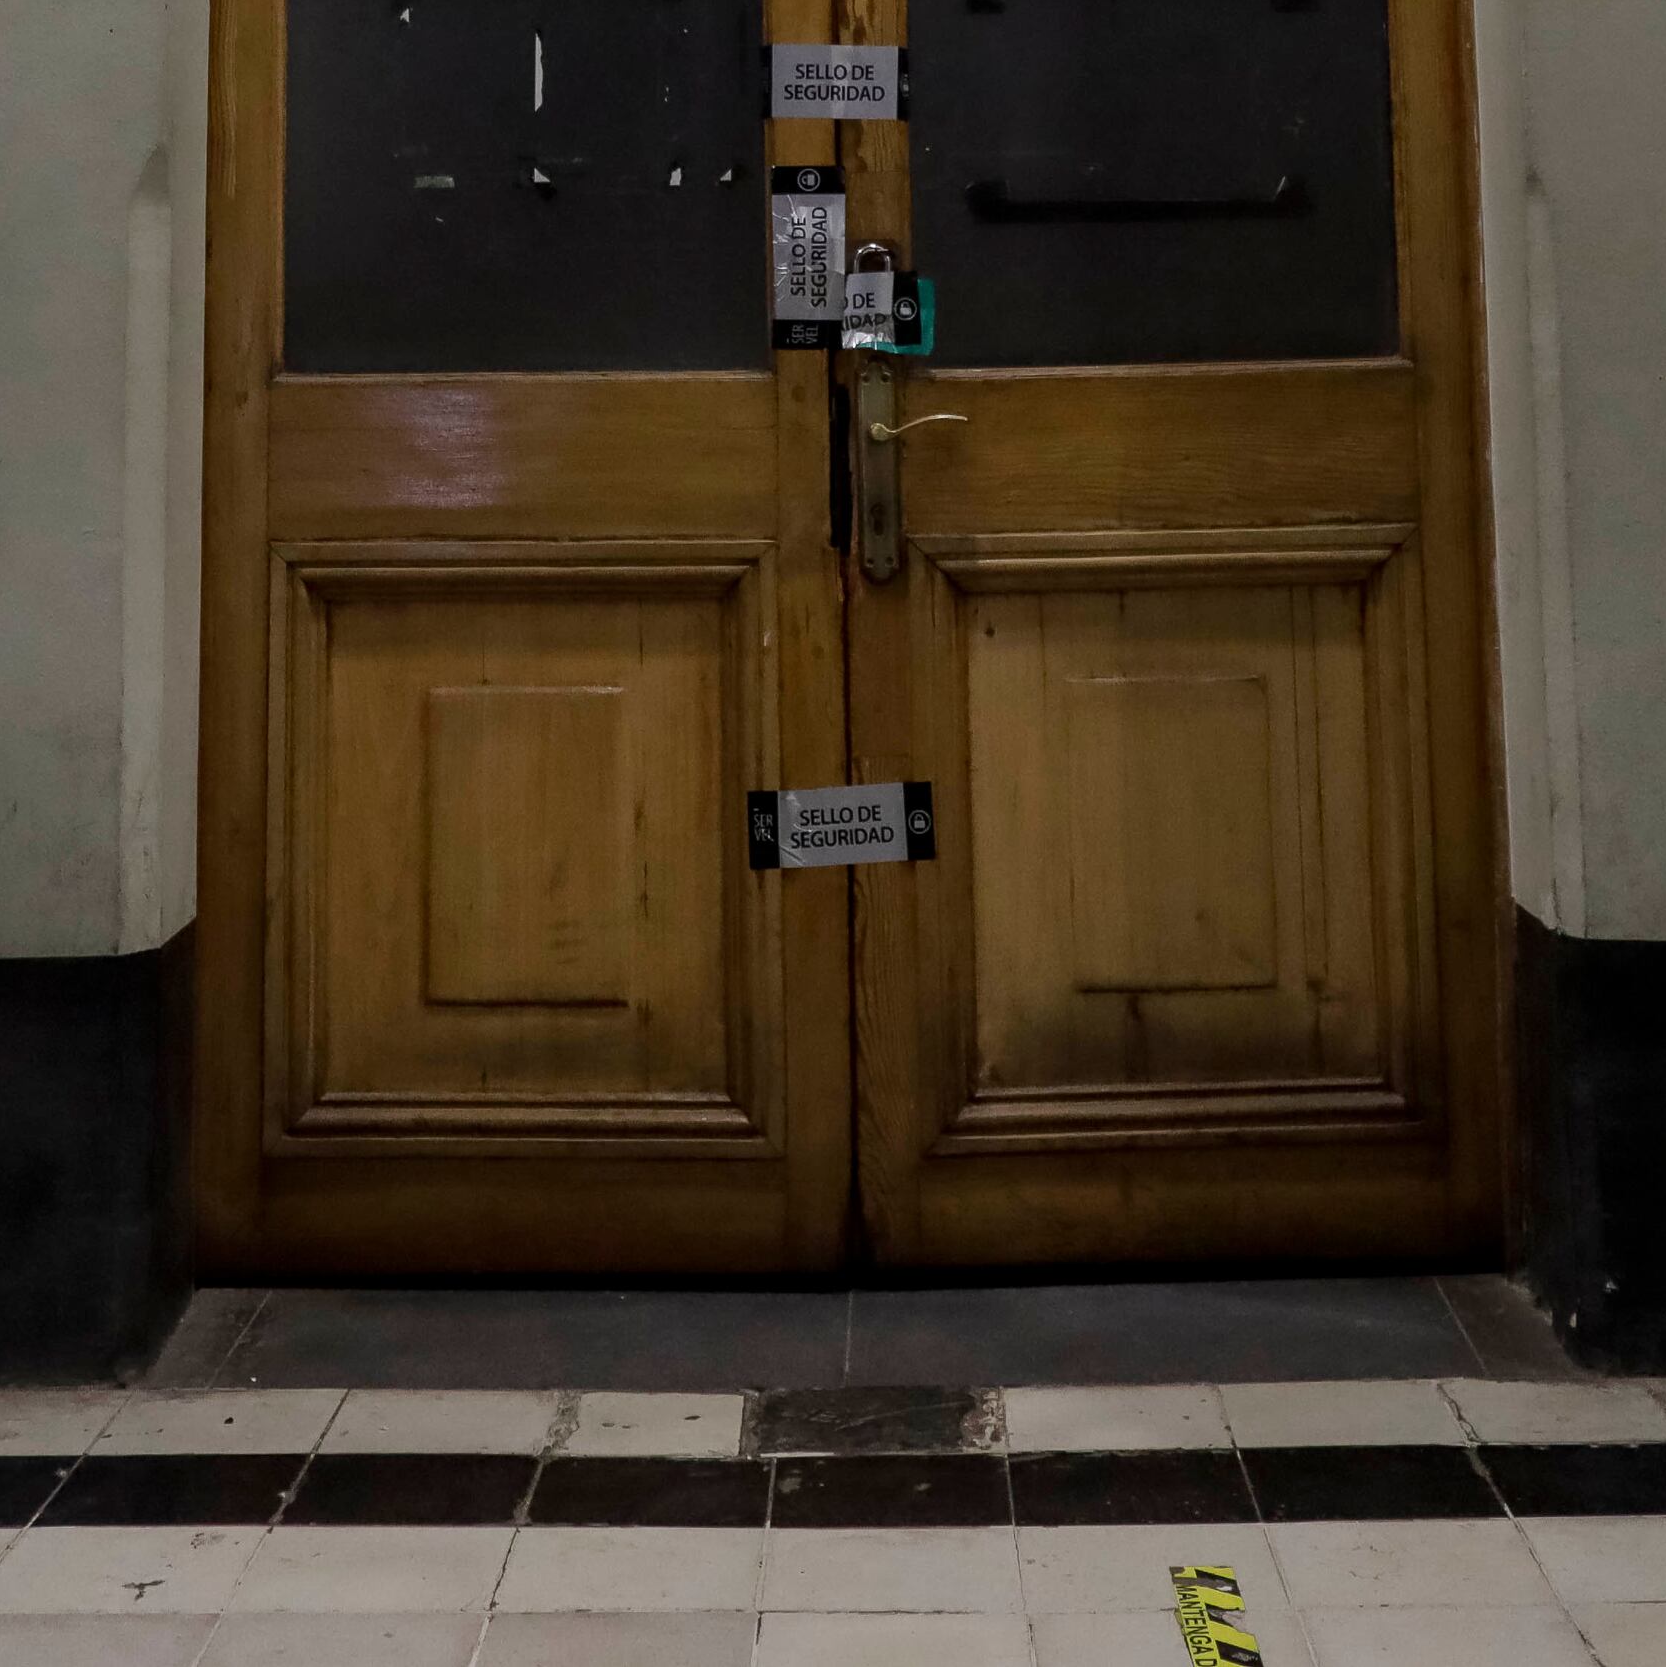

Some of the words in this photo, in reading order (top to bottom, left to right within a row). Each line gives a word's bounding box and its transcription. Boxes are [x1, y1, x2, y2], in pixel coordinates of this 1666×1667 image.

[795, 64, 847, 80] SELLO
[851, 64, 874, 80] DE
[783, 85, 885, 102] SEGURIDAD
[792, 217, 806, 239] DE
[811, 207, 827, 308] SEGURIDAD
[791, 243, 806, 297] SELLO
[853, 292, 876, 310] DE
[791, 324, 804, 344] SER
[806, 325, 819, 344] VEL
[753, 813, 773, 827] SER
[799, 806, 853, 827] SELLO
[858, 805, 882, 823] DE
[753, 828, 773, 842] VEL
[790, 826, 894, 849] SEGURIDAD
[1176, 1585, 1214, 1655] MANTENGA
